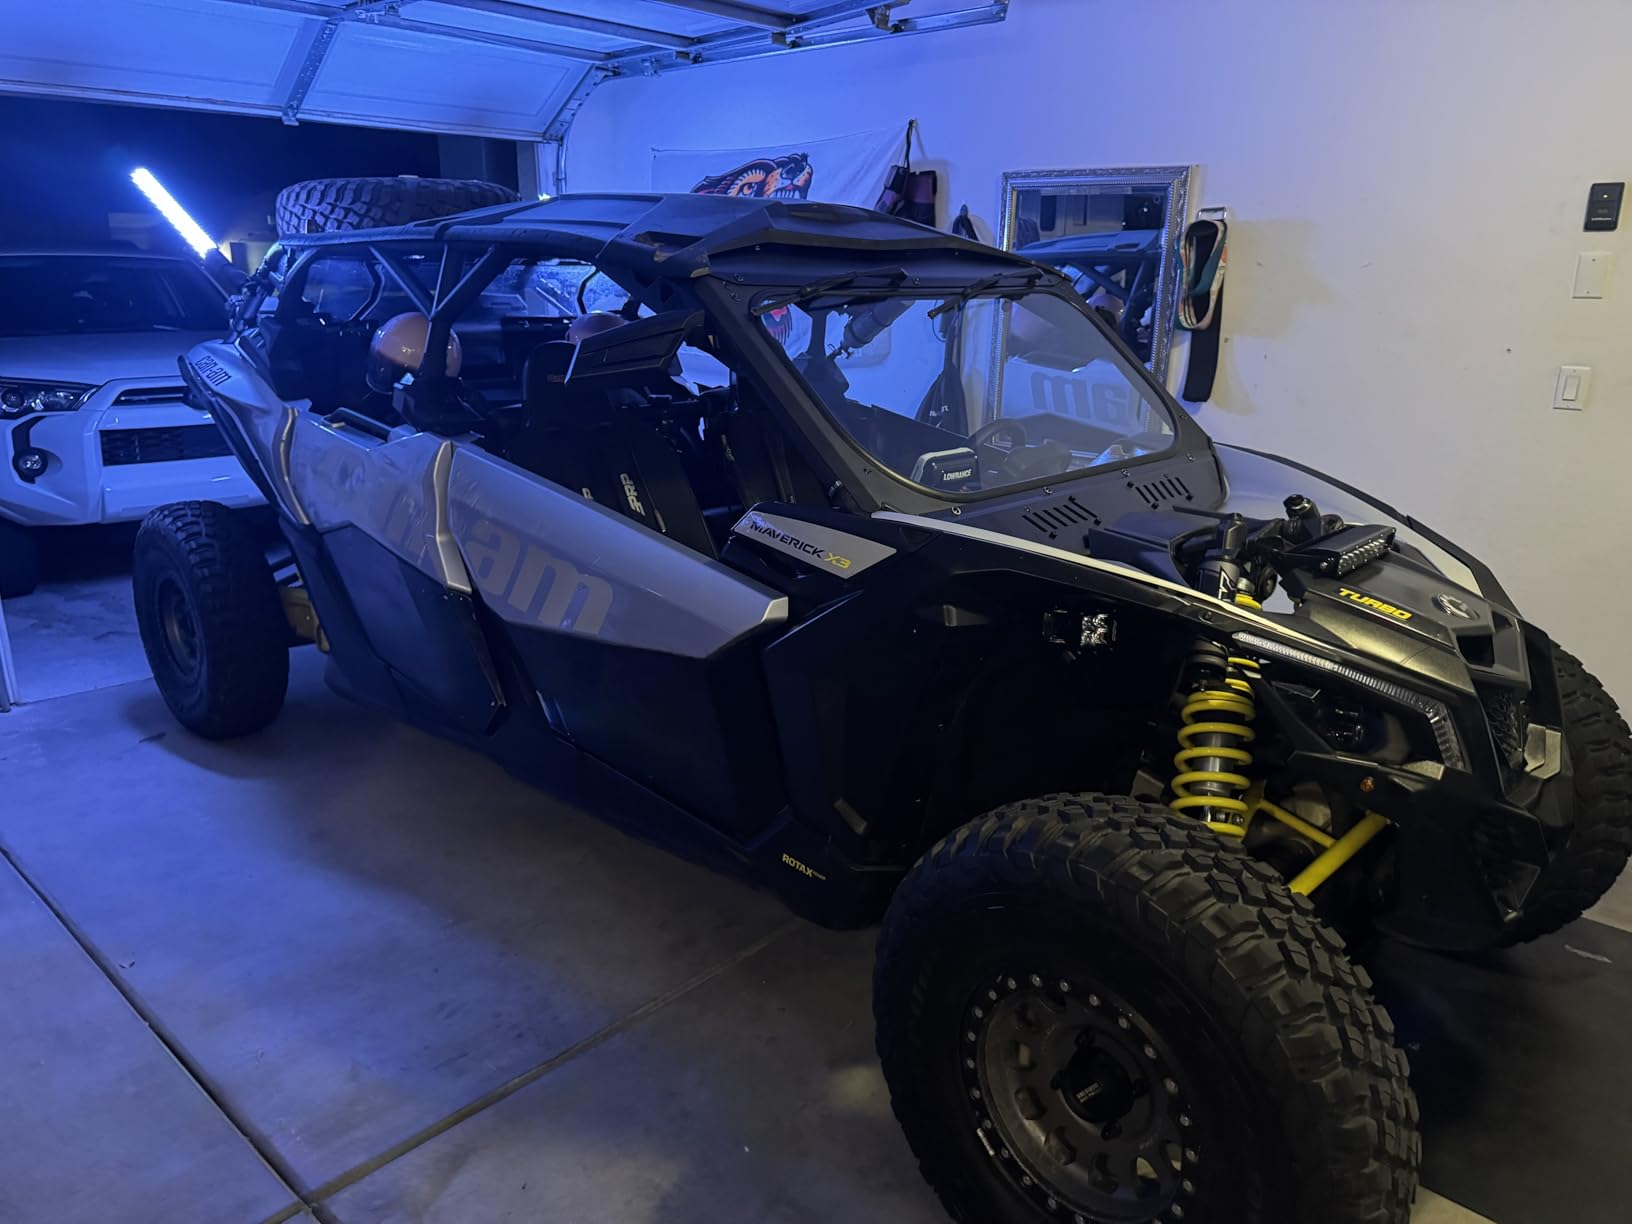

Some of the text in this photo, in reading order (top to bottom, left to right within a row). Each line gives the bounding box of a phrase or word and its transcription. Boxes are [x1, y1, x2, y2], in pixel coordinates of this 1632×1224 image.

[943, 468, 973, 481] LOWRANCE
[620, 473, 646, 517] PRP
[750, 521, 852, 569] MAVERICK X3
[1339, 587, 1413, 620] TURBO
[782, 852, 814, 878] ROTAX
